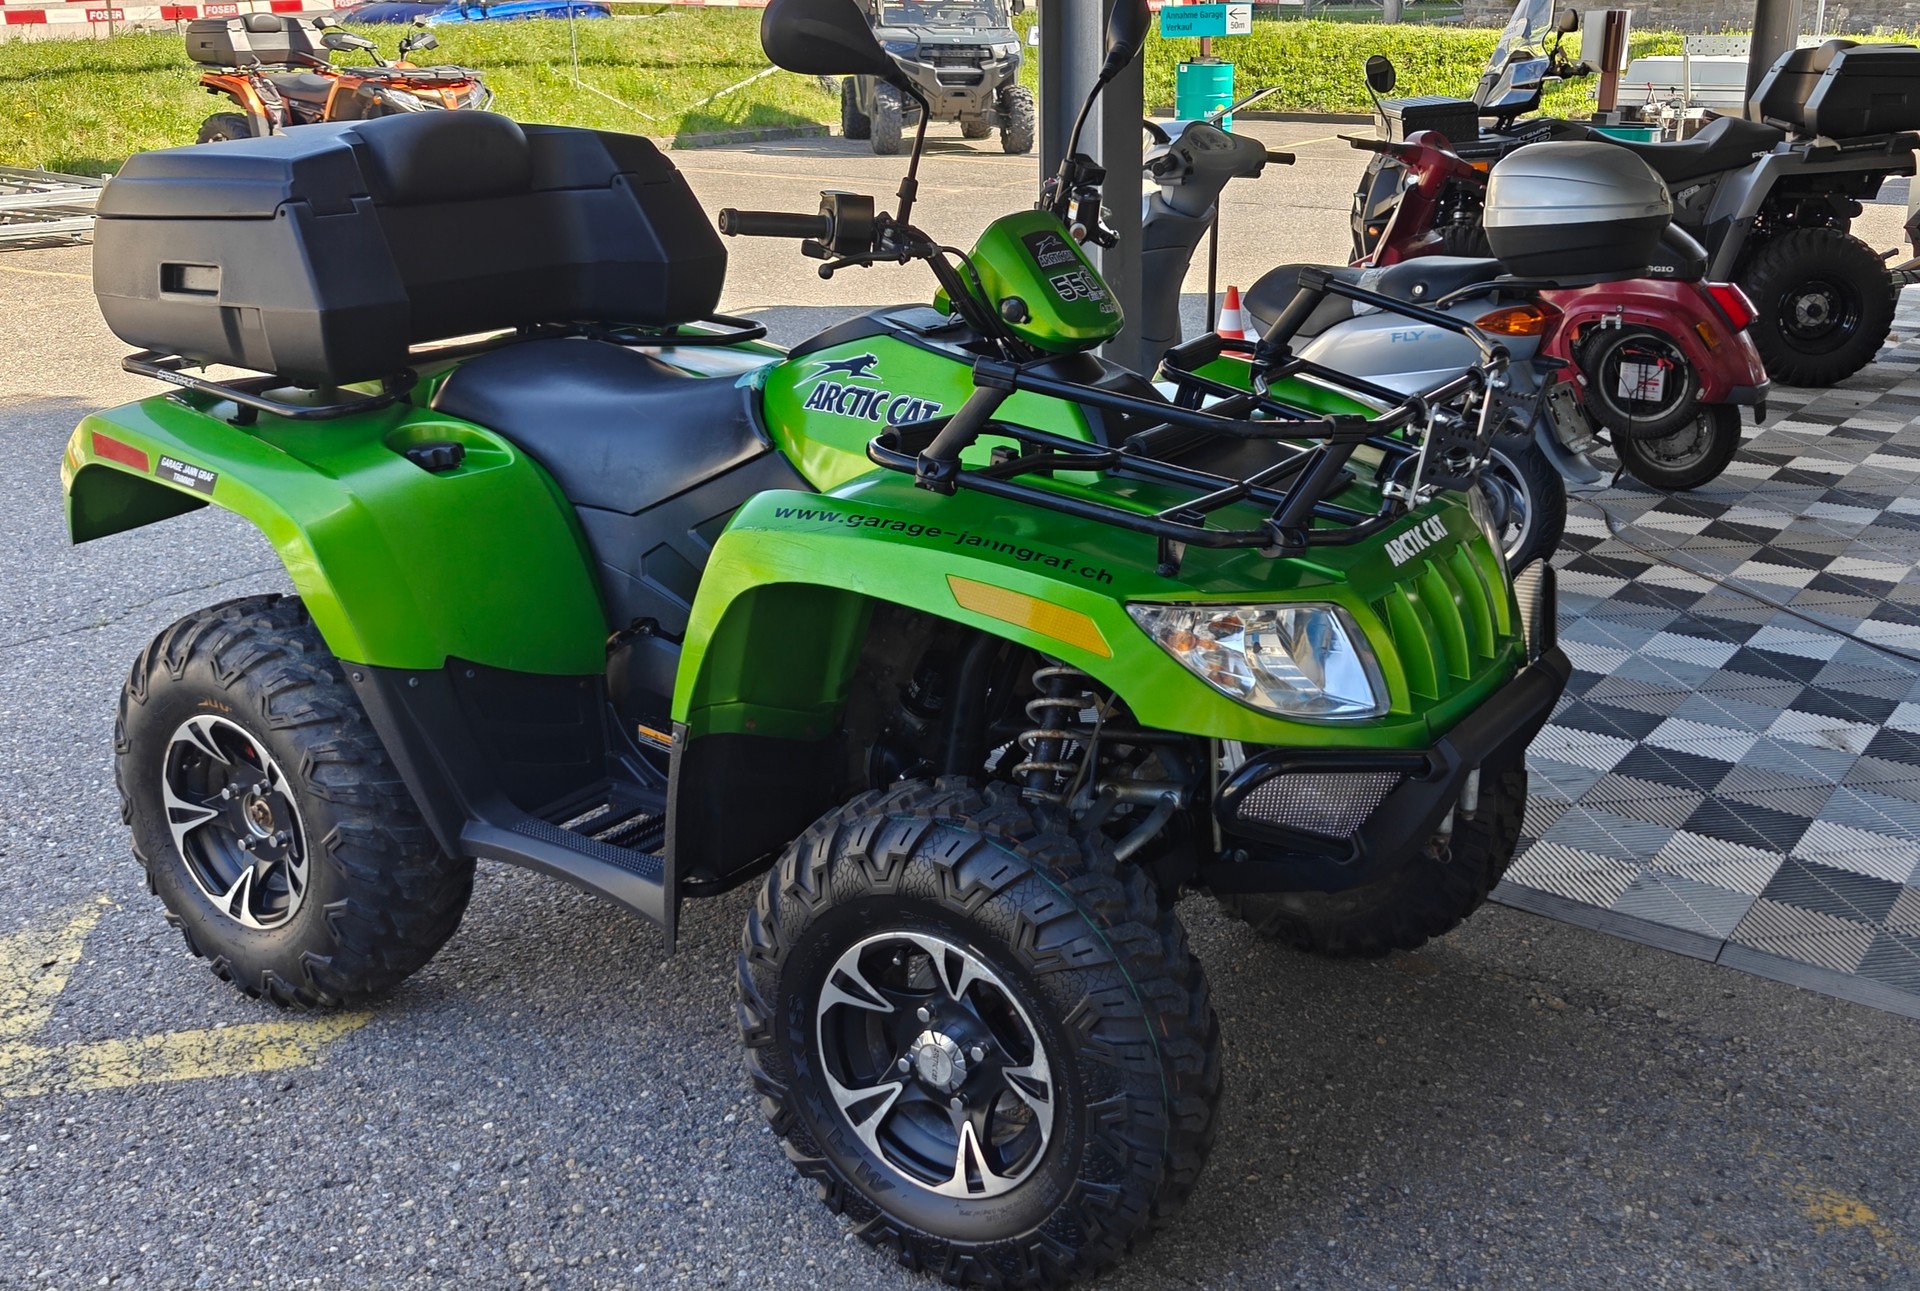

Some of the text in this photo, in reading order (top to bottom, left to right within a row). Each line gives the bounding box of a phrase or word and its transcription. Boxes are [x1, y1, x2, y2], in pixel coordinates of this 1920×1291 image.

[90, 10, 122, 20] FOSER
[205, 5, 236, 15] FOSER
[1166, 10, 1224, 20] Annahme Garage
[1166, 23, 1193, 32] Verkauf
[1230, 21, 1245, 29] 50m
[1049, 272, 1100, 301] 550
[1391, 330, 1424, 343] FLY
[804, 381, 943, 426] ARCTIC CAT
[161, 457, 184, 472] GARAGE
[198, 470, 215, 482] GRAF
[775, 507, 1113, 585] www.garage-janngraf.ch
[1384, 514, 1448, 567] ARCTIC CAT
